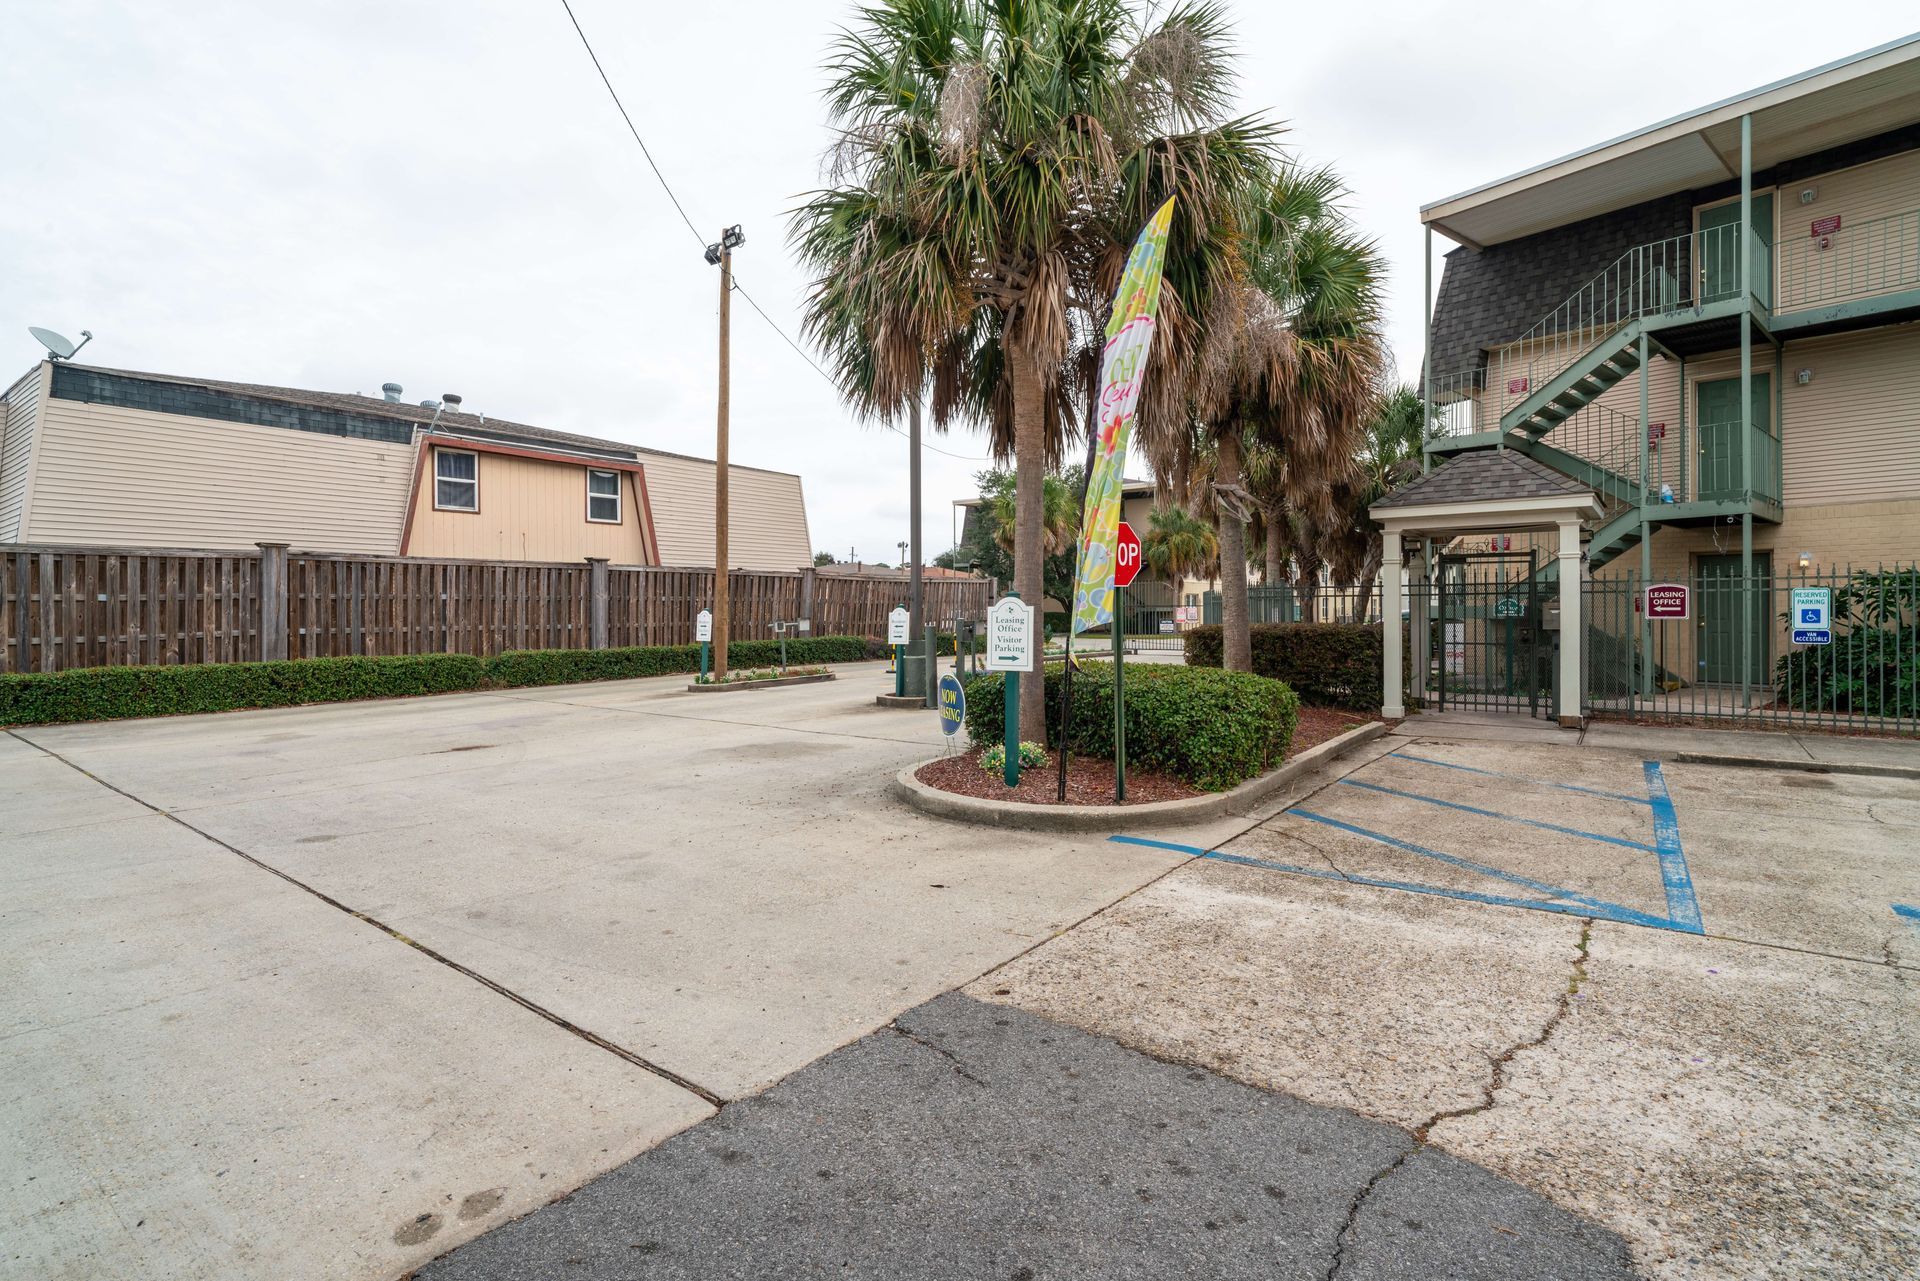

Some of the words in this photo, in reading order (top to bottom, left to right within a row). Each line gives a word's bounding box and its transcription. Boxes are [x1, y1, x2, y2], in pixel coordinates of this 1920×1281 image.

[1117, 542, 1139, 567] OP
[995, 616, 1025, 625] Leasing
[997, 624, 1023, 633] Office
[997, 635, 1023, 644] Visitor
[994, 644, 1025, 654] Parking
[941, 687, 957, 705] NOW
